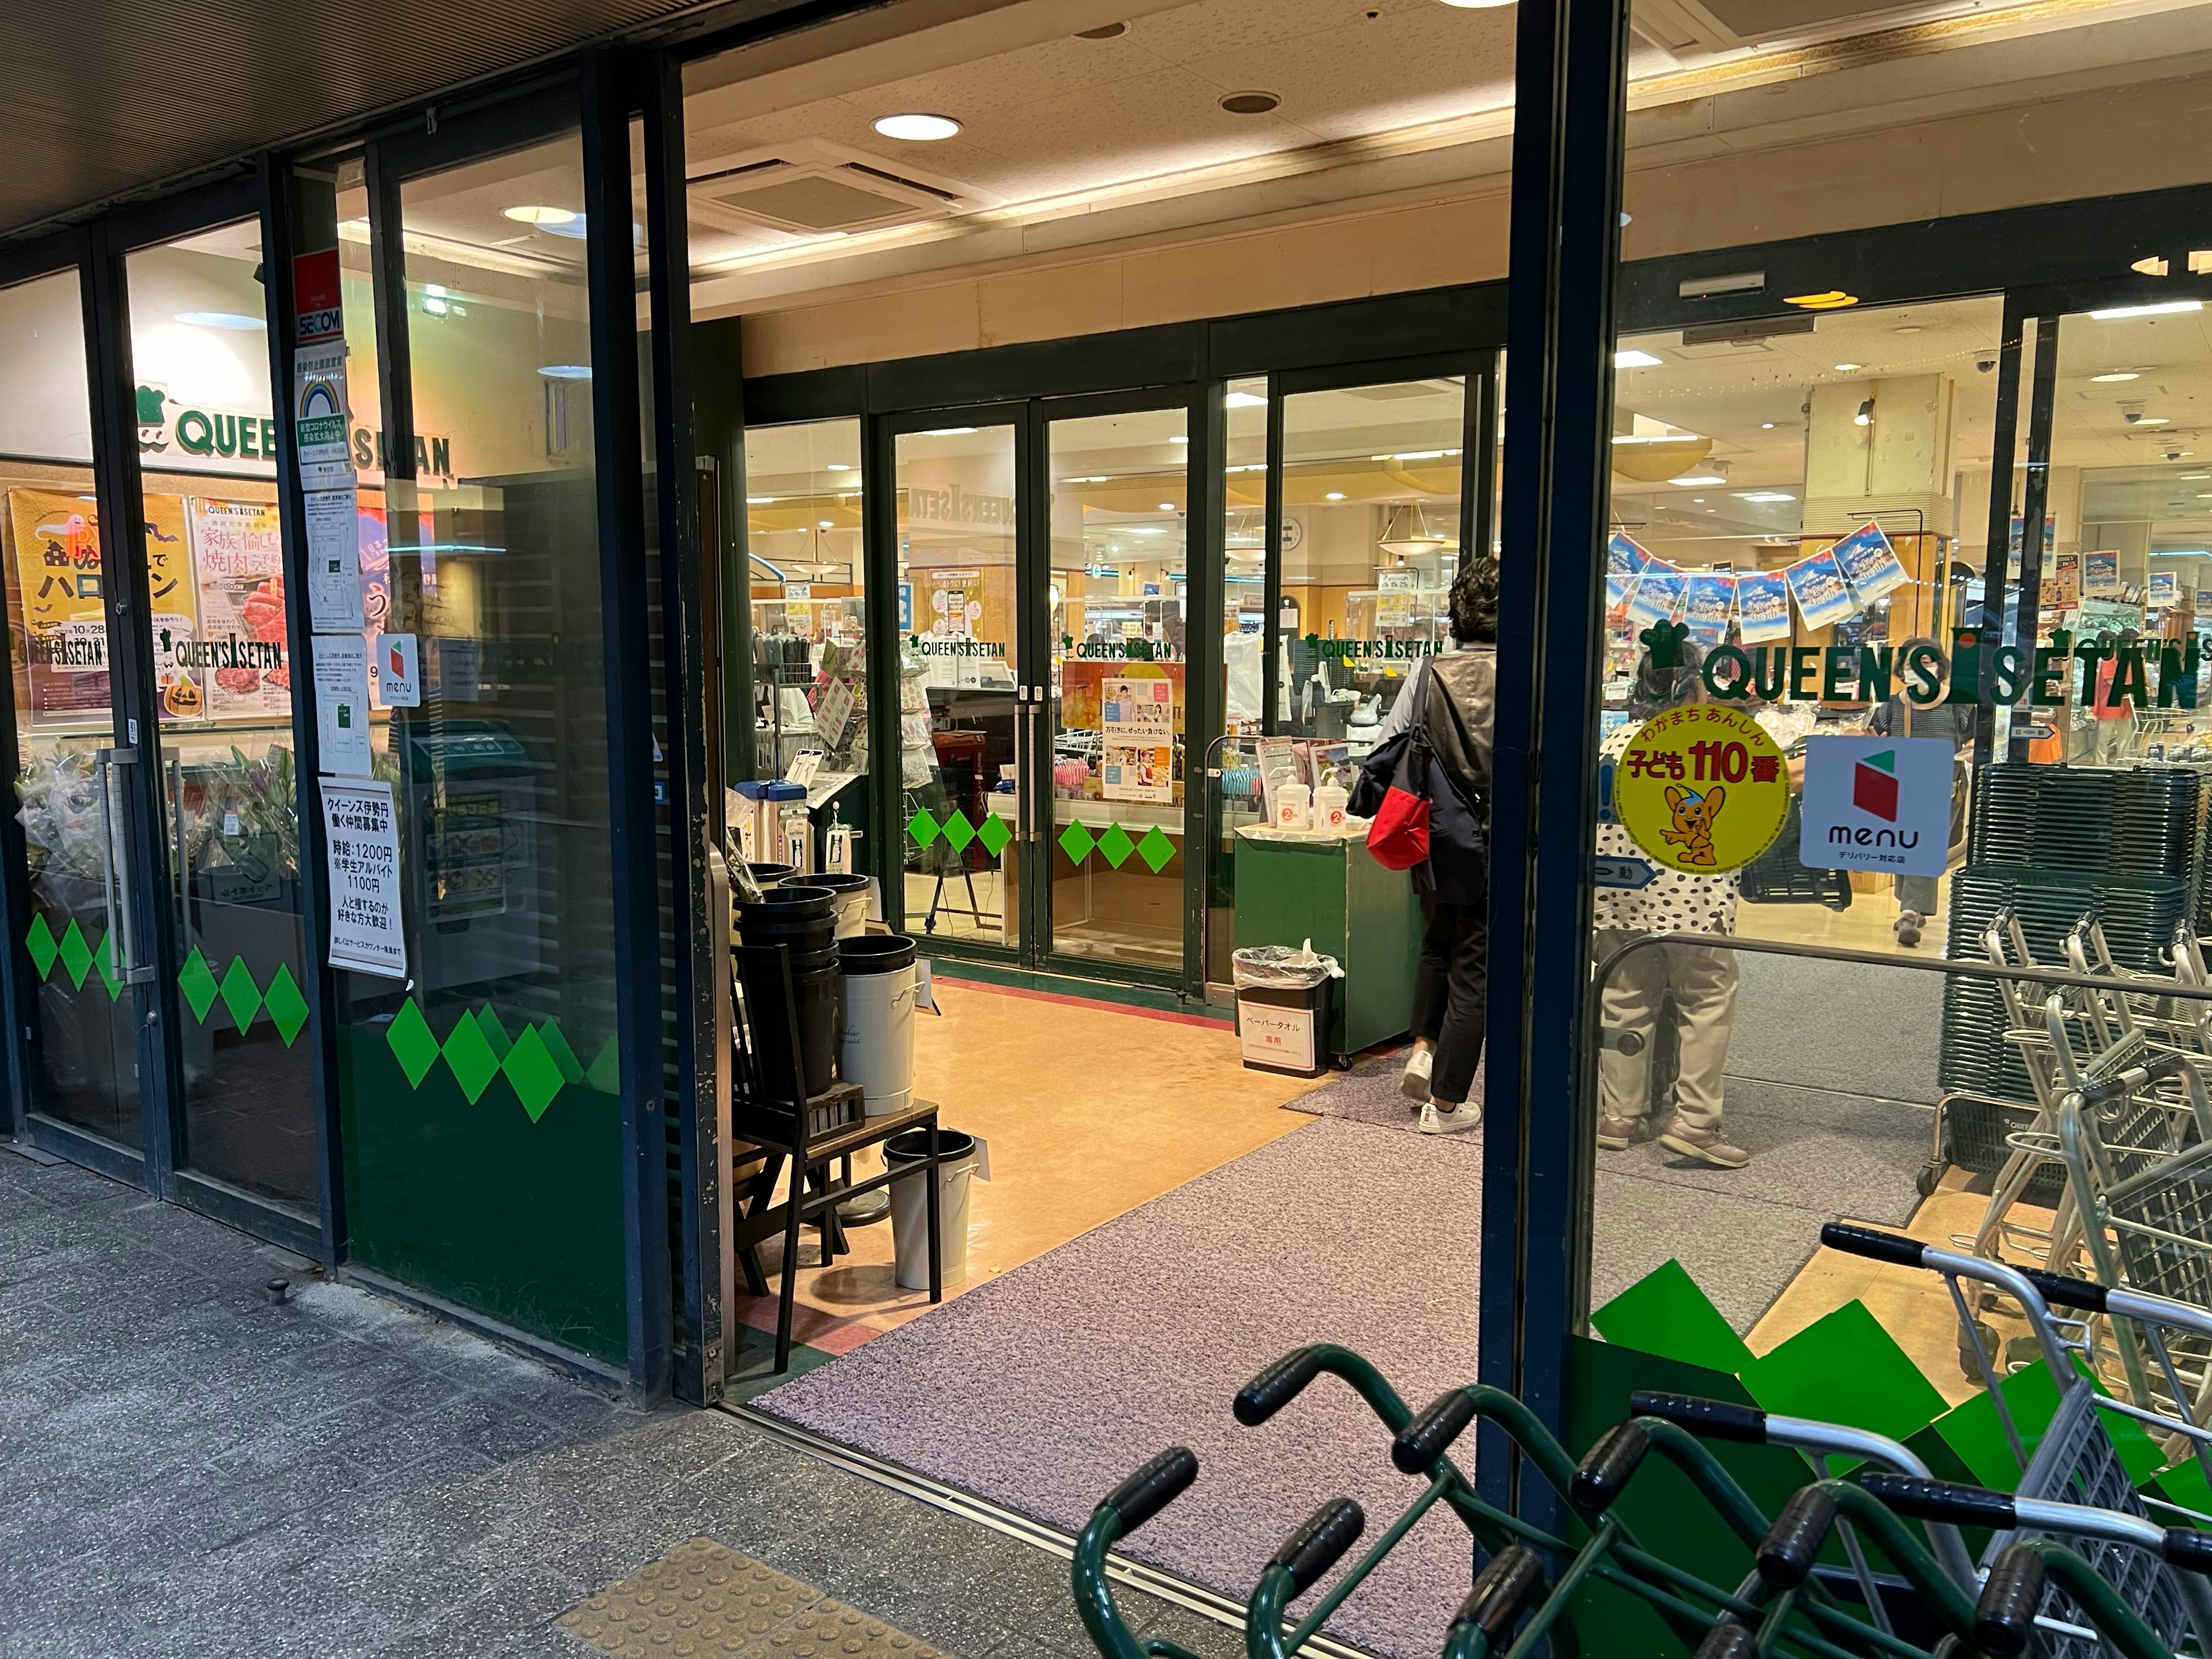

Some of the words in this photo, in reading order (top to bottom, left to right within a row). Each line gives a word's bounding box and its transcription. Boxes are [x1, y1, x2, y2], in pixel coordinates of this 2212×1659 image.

[300, 310, 339, 335] SECOM
[301, 420, 341, 432] 新型コロナウイルス
[208, 506, 239, 515] QUEEN'S
[240, 505, 265, 516] ISETAN
[203, 549, 247, 574] 焼肉
[176, 641, 229, 668] QUEEN'S
[229, 633, 282, 670] ISETAN
[922, 641, 964, 657] QUEEN'S
[966, 637, 1006, 657] ISETAN
[1076, 642, 1126, 658] QUEEN'S
[1126, 637, 1172, 658] ISETAN
[1322, 640, 1385, 658] QUEEN'S
[1385, 635, 1443, 658] ISETAN
[1703, 645, 1940, 703] QUEEN'S
[1950, 627, 2200, 708] ISETAN
[386, 682, 411, 692] menu
[1105, 726, 1170, 736] 万引きに、ぜったい負けない。
[1640, 708, 1701, 742] わがまち
[1706, 708, 1765, 747] あんしん
[328, 798, 388, 817] クイーンズ伊勢丹
[331, 813, 388, 833] 働く仲間募集中
[1829, 826, 1918, 849] menu
[334, 857, 393, 878] ※学生アルバイト
[1839, 851, 1906, 864] デリバリー対応店
[347, 875, 380, 893] 1100円
[342, 895, 388, 915] 人と接するのが
[1246, 1017, 1300, 1032] ペーパータオル
[1265, 1035, 1281, 1046] 専用
